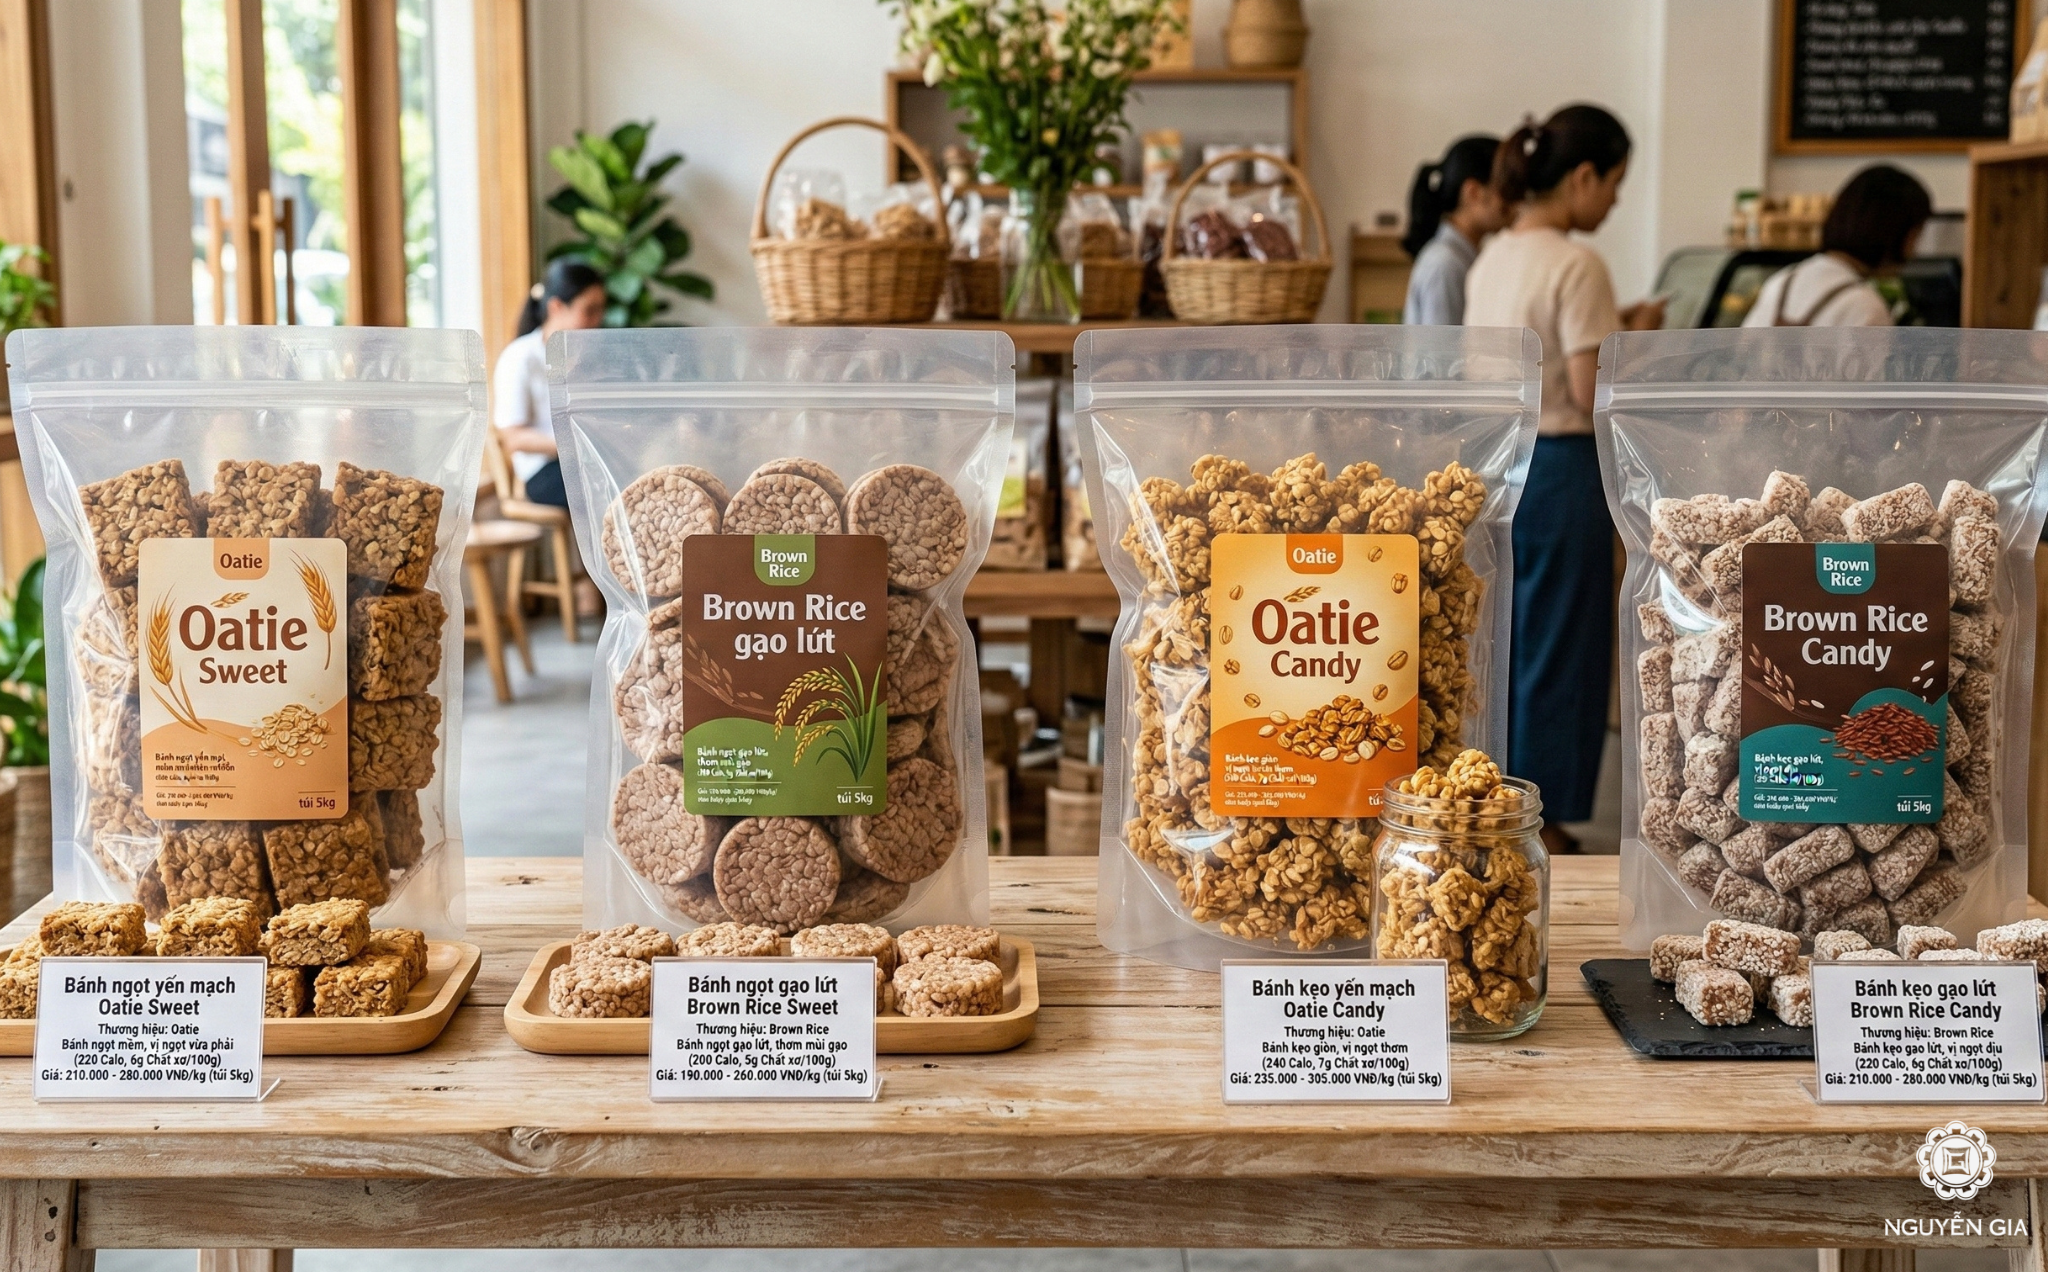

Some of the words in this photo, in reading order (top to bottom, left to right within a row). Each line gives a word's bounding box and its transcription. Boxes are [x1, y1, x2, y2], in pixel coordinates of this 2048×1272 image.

[220, 553, 263, 569] Oatie
[761, 549, 808, 564] Brown
[1293, 547, 1337, 565] Oatie
[769, 564, 800, 578] Rice
[1823, 557, 1870, 572] Brown
[1831, 572, 1862, 587] Rice
[703, 594, 795, 621] Brown
[805, 594, 866, 621] Rice
[1252, 598, 1380, 646] Oatie
[1764, 604, 1857, 632] Brown
[1867, 605, 1928, 632] Rice
[179, 605, 308, 651] Oatie
[734, 633, 787, 661] gạo
[797, 627, 836, 654] lứt
[1801, 638, 1892, 672] Candy
[199, 657, 287, 684] Sweet
[1270, 650, 1362, 684] Candy
[298, 797, 314, 808] túi
[316, 797, 336, 810] 5kg
[837, 792, 852, 804] túi
[1368, 793, 1384, 806] tú
[1897, 800, 1911, 812] túi
[1913, 800, 1932, 814] 5kg
[64, 975, 107, 993] Bánh
[112, 977, 150, 997] ngọt
[155, 974, 185, 997] yến
[190, 976, 235, 997] mạch
[688, 975, 730, 993] Bánh
[736, 977, 774, 997] ngọt
[779, 980, 810, 997] gạo
[815, 976, 838, 993] lứt
[1252, 979, 1294, 996] Bánh
[1299, 979, 1330, 1000] kẹo
[1335, 978, 1364, 1000] yến
[1370, 979, 1415, 1000] mạch
[1855, 979, 1897, 997] Bánh
[1902, 979, 1933, 1000] kẹo
[1938, 984, 1968, 1000] gạo
[1973, 979, 1997, 997] lứt
[99, 998, 143, 1015] Oatie
[148, 998, 200, 1015] Sweet
[687, 998, 740, 1015] Brown
[745, 998, 782, 1015] Rice
[787, 998, 839, 1015] Sweet
[1284, 1001, 1328, 1018] Oatie
[1333, 1001, 1385, 1022] Candy
[1851, 1002, 1903, 1018] Brown
[1909, 1001, 1945, 1018] Rice
[1950, 1001, 2002, 1022] Candy
[98, 1023, 139, 1037] Thương
[141, 1023, 168, 1037] hiệu:
[171, 1023, 200, 1035] Oatie
[696, 1023, 737, 1037] Thương
[740, 1023, 766, 1037] hiệu:
[769, 1023, 803, 1035] Brown
[806, 1023, 829, 1035] Rice
[1284, 1026, 1325, 1040] Thương
[1328, 1026, 1354, 1040] hiệu:
[1357, 1026, 1386, 1038] Oatie
[1860, 1027, 1902, 1040] Thương
[1904, 1026, 1931, 1040] hiệu:
[1934, 1027, 1968, 1038] Brown
[1971, 1027, 1994, 1038] Rice
[61, 1038, 88, 1050] Bánh
[91, 1039, 115, 1053] ngọt
[150, 1038, 159, 1053] vị
[162, 1039, 186, 1053] ngọt
[189, 1038, 208, 1050] vừa
[211, 1037, 234, 1053] phải
[677, 1038, 703, 1050] Bánh
[706, 1039, 730, 1053] ngọt
[733, 1041, 752, 1053] gạo
[755, 1038, 772, 1052] lứt,
[775, 1039, 803, 1050] thơm
[805, 1038, 825, 1050] mùi
[828, 1041, 847, 1053] gạo
[1262, 1042, 1289, 1053] Bánh
[1292, 1042, 1311, 1055] kẹo
[1313, 1042, 1340, 1056] giòn,
[1342, 1042, 1351, 1054] vị
[1354, 1043, 1378, 1056] ngọt
[1381, 1042, 1408, 1053] thơm
[1854, 1042, 1880, 1054] Bánh
[1883, 1042, 1903, 1056] kẹo
[1947, 1042, 1957, 1056] vị
[1960, 1043, 1984, 1056] ngọt
[1986, 1042, 2002, 1056] dịu
[74, 1054, 98, 1068] (220
[100, 1054, 127, 1067] Calo,
[130, 1054, 144, 1067] 6g
[146, 1051, 171, 1065] Chất
[173, 1054, 222, 1068] xơ/100g)
[688, 1054, 712, 1067] (200
[715, 1054, 742, 1067] Calo,
[745, 1054, 758, 1067] 5g
[761, 1052, 785, 1065] Chất
[788, 1054, 836, 1068] xơ/100g)
[1262, 1057, 1286, 1071] (240
[1288, 1057, 1316, 1070] Calo,
[1319, 1058, 1332, 1071] 7g
[1334, 1056, 1359, 1069] Chất
[1362, 1057, 1409, 1071] xơ/100g)
[1855, 1058, 1880, 1072] (220
[1882, 1058, 1909, 1071] Calo,
[1911, 1058, 1925, 1071] 6g
[1927, 1056, 1953, 1069] Chất
[41, 1068, 63, 1081] Giá:
[66, 1069, 109, 1081] 210.000
[119, 1069, 163, 1081] 280.000
[166, 1069, 206, 1083] VNĐ/kg
[656, 1068, 678, 1081] Giá:
[681, 1069, 724, 1081] 190.000
[733, 1069, 777, 1081] 260.000
[844, 1069, 868, 1083] 5kg)
[1230, 1072, 1252, 1084] Giá:
[1254, 1073, 1297, 1084] 235.000
[1307, 1073, 1351, 1084] 305.000
[1354, 1072, 1395, 1087] VNĐ/kg
[1418, 1072, 1442, 1087] 5kg)
[1825, 1073, 1847, 1084] Giá:
[1849, 1074, 1892, 1084] 210.000
[1903, 1074, 1946, 1084] 280.000
[1949, 1074, 1989, 1087] VNĐ/kg
[2013, 1073, 2037, 1088] 5kg)
